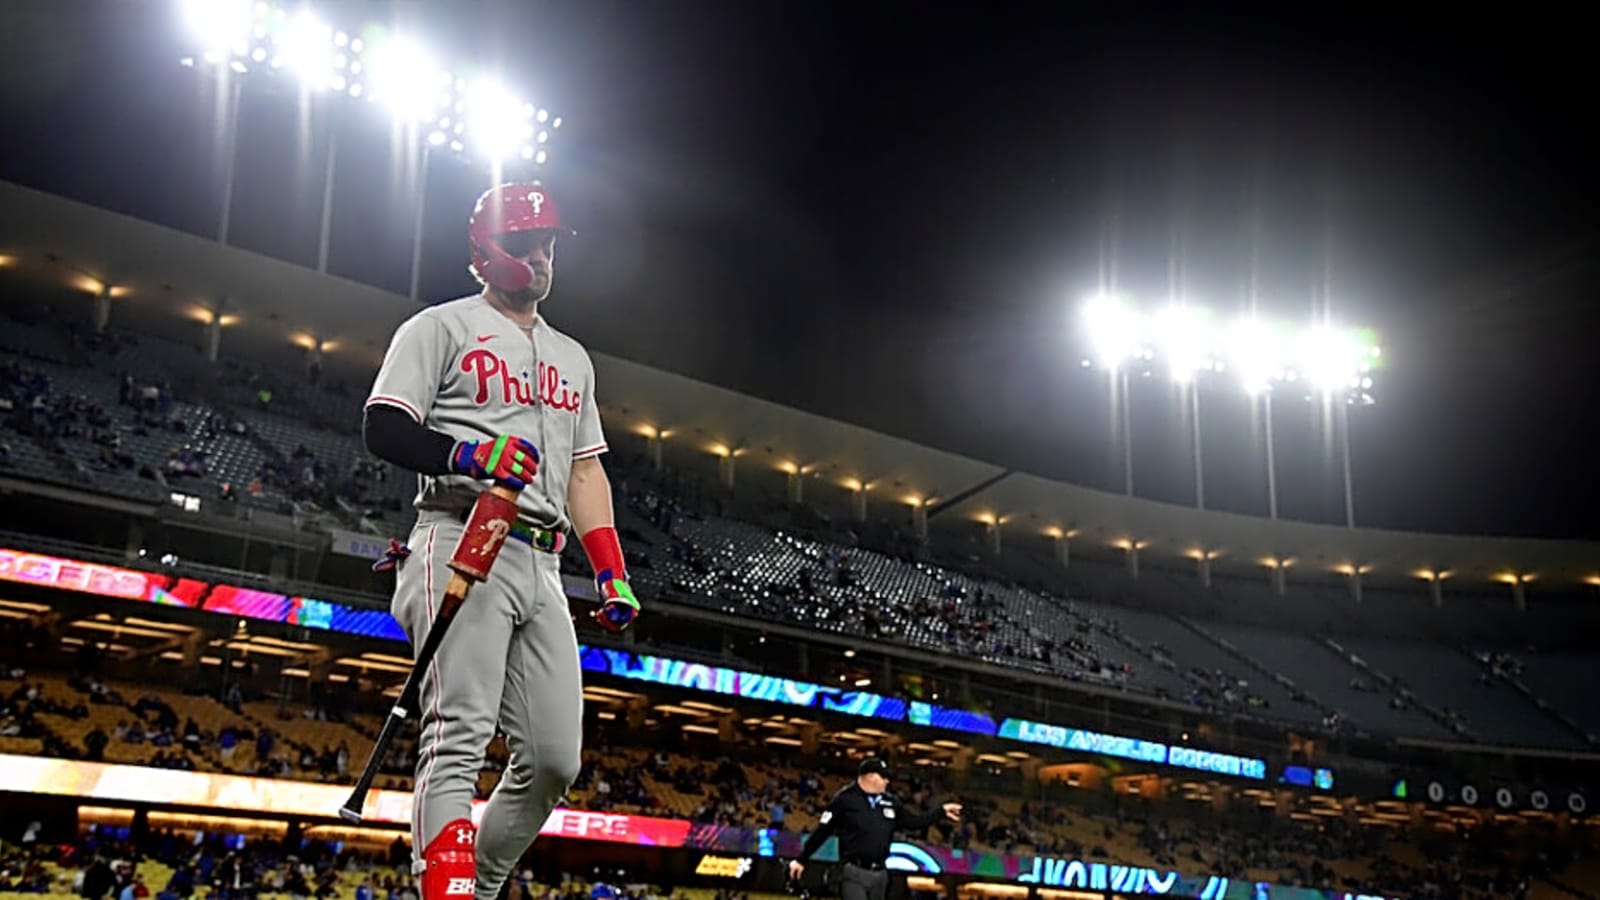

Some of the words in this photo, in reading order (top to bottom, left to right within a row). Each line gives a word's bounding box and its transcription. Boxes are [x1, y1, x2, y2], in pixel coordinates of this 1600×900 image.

[528, 192, 544, 214] P
[480, 518, 510, 556] P
[1018, 720, 1066, 746] LOS
